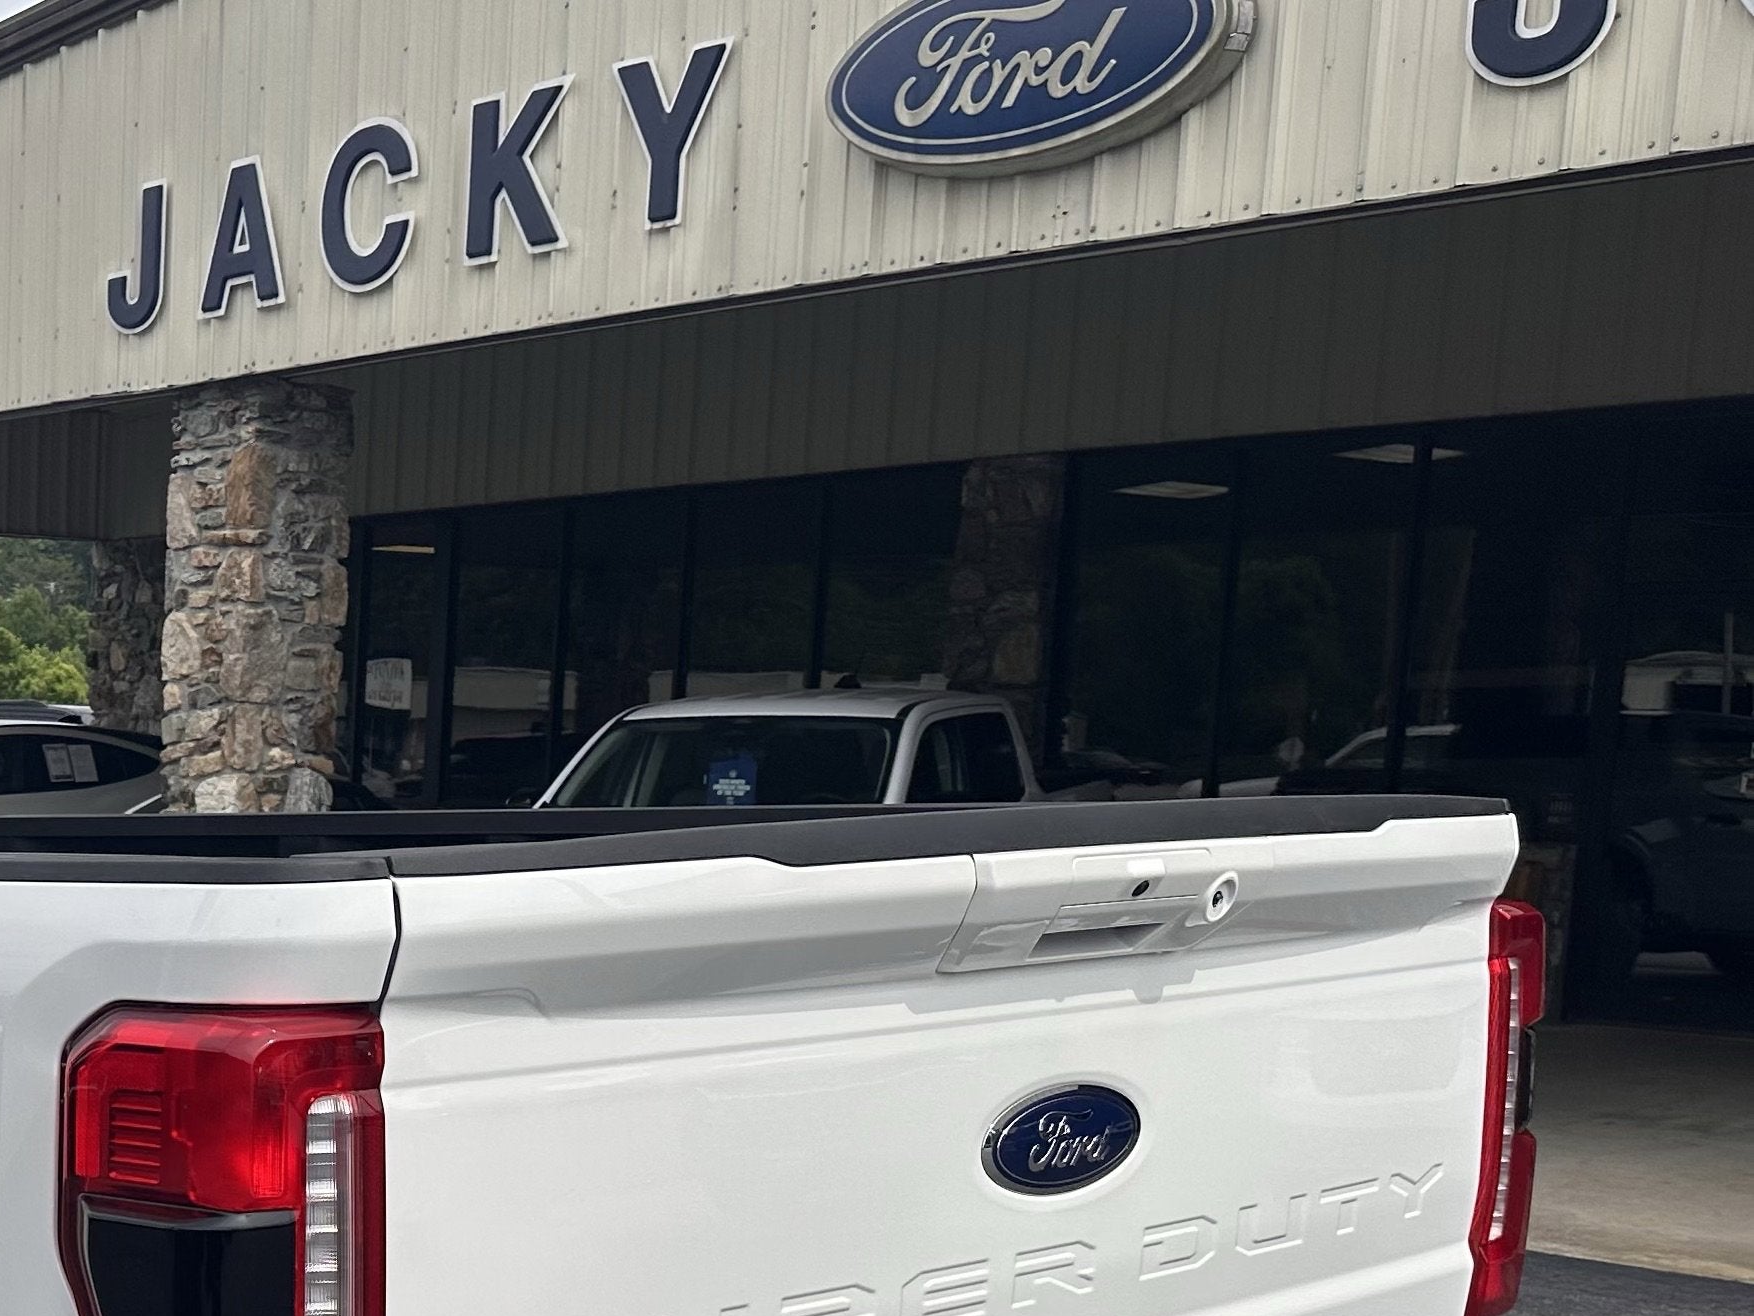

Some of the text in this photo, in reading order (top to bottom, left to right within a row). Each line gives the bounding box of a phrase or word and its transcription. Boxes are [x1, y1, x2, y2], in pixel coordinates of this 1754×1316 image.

[894, 0, 1128, 127] Ford
[106, 36, 735, 334] JACKY
[1028, 1108, 1111, 1172] Ford
[1138, 1162, 1445, 1282] DUTY
